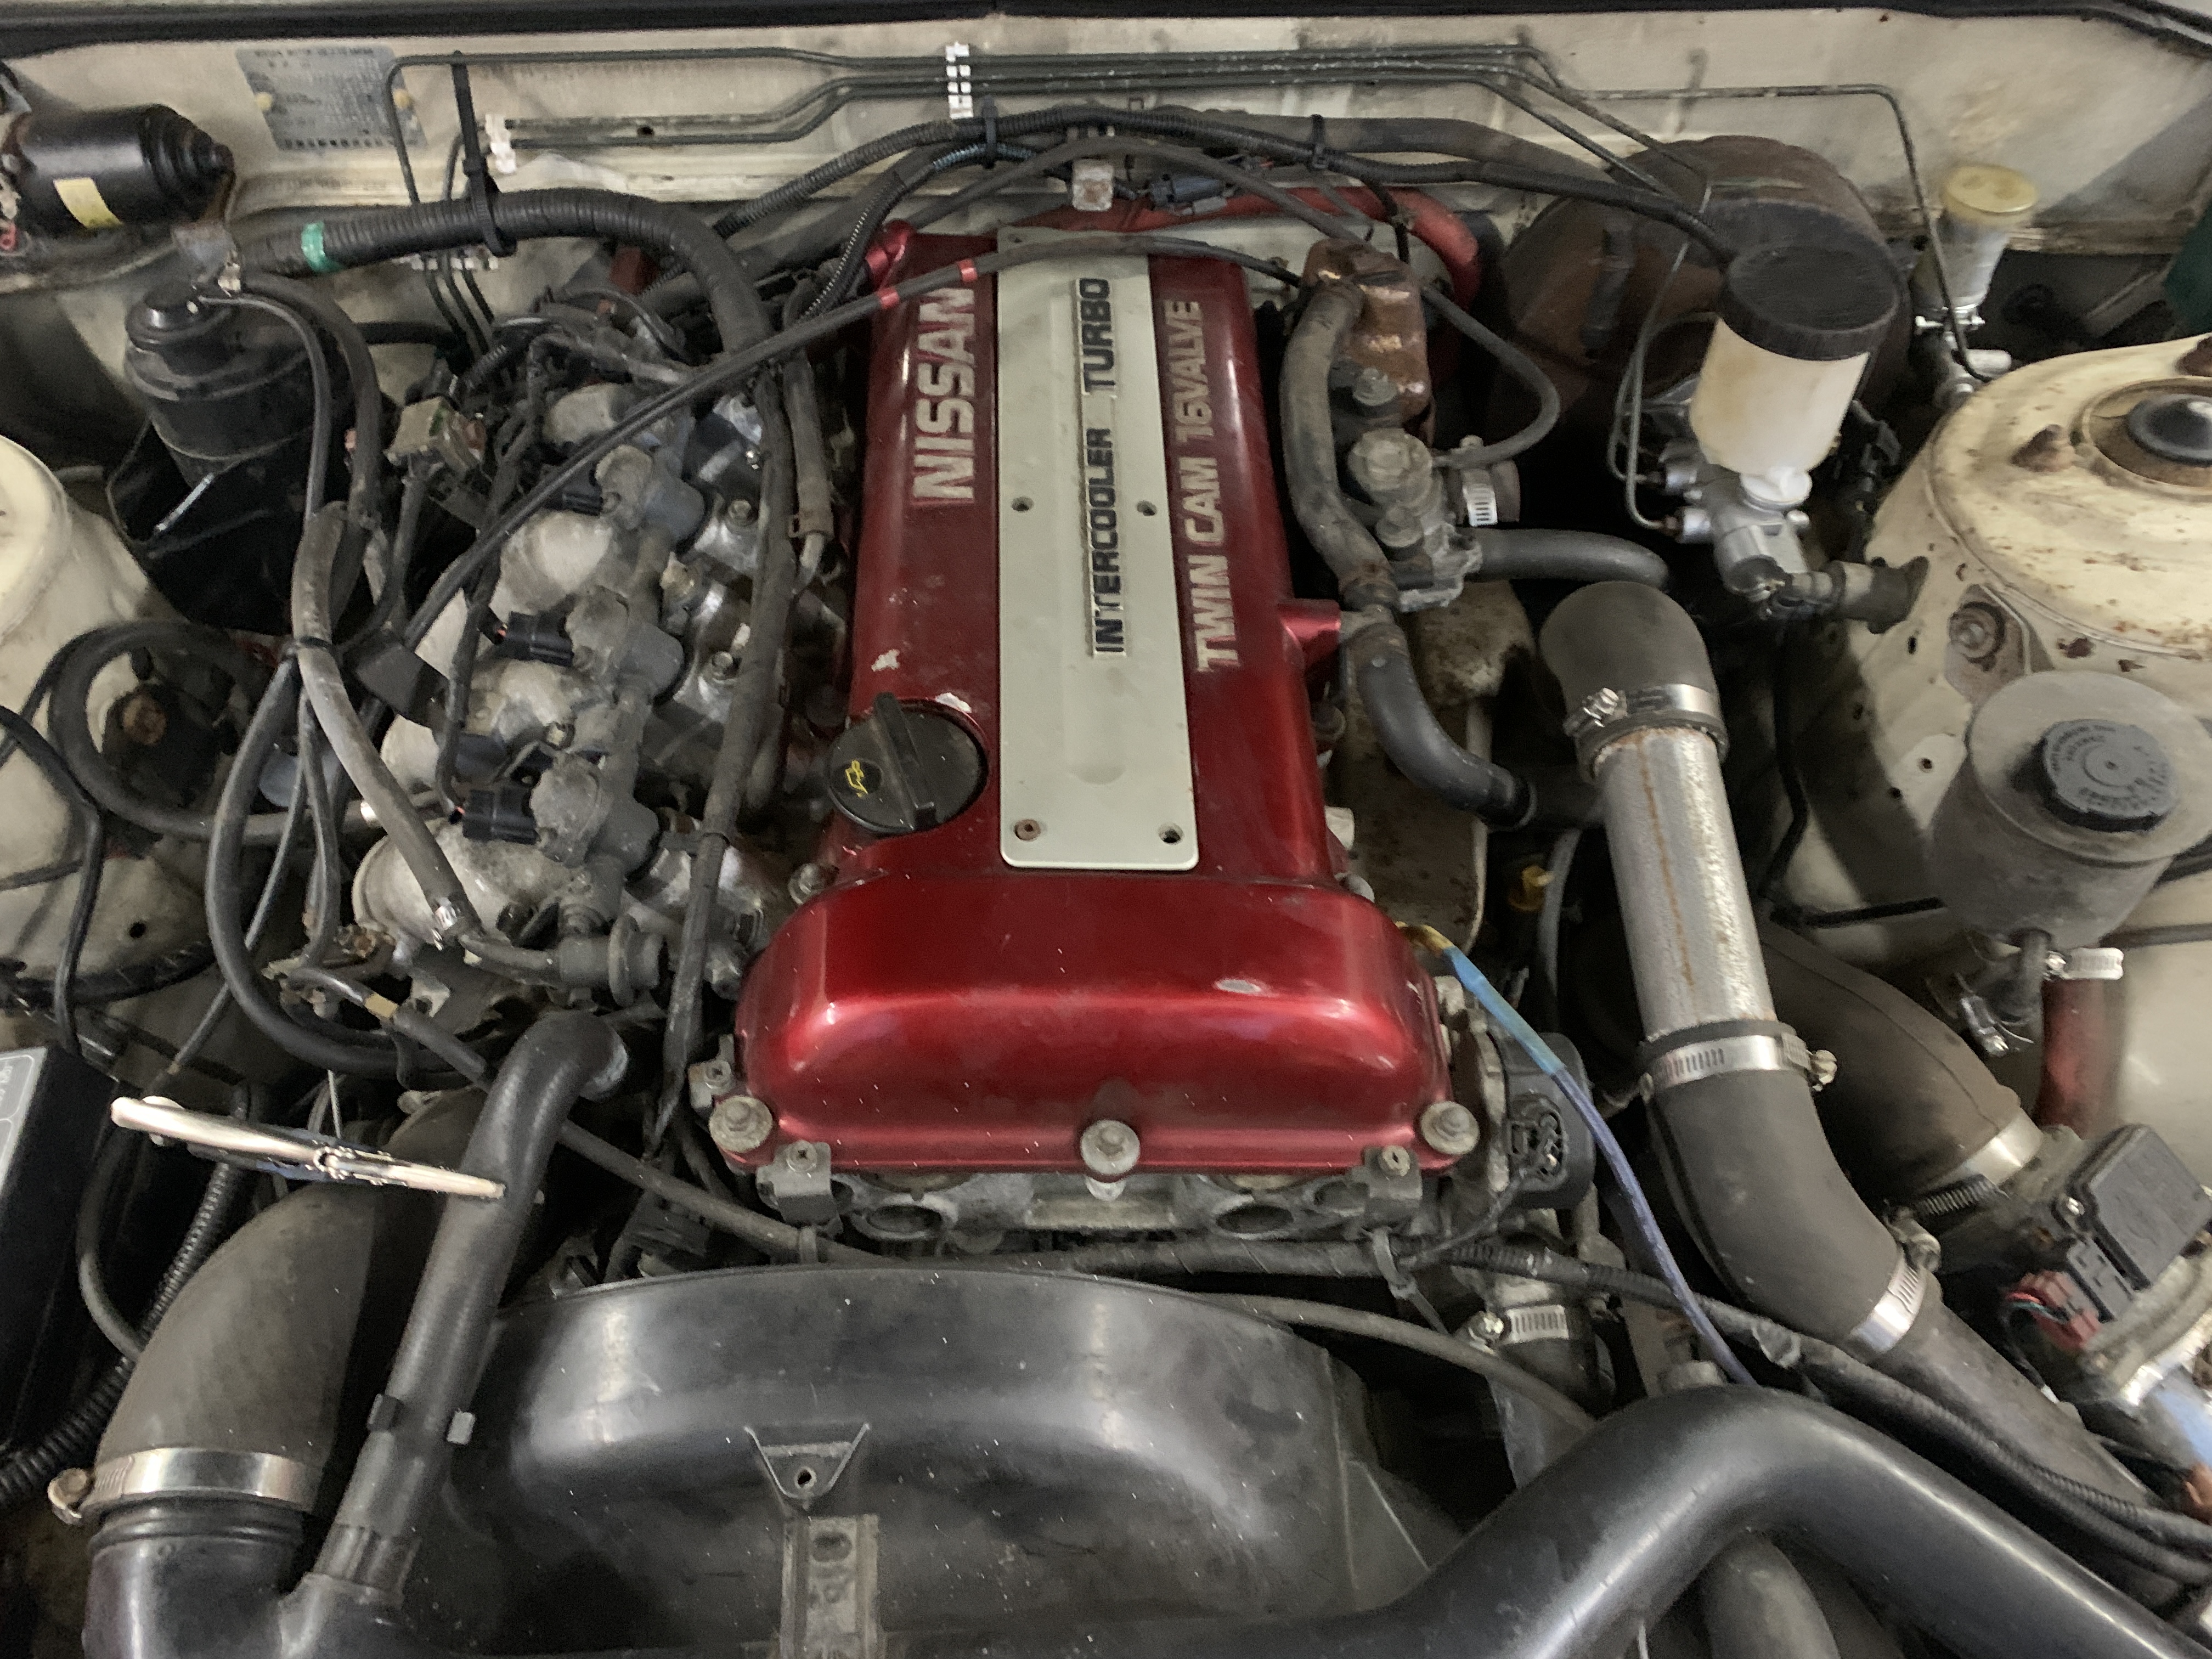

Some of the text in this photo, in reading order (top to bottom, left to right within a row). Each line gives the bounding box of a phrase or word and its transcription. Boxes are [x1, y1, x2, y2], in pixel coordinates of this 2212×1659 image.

[913, 288, 975, 499] NISSAN
[1079, 278, 1124, 652] INTERCOOLER TURBO
[1164, 301, 1239, 673] TWIN CAM 16VALVE
